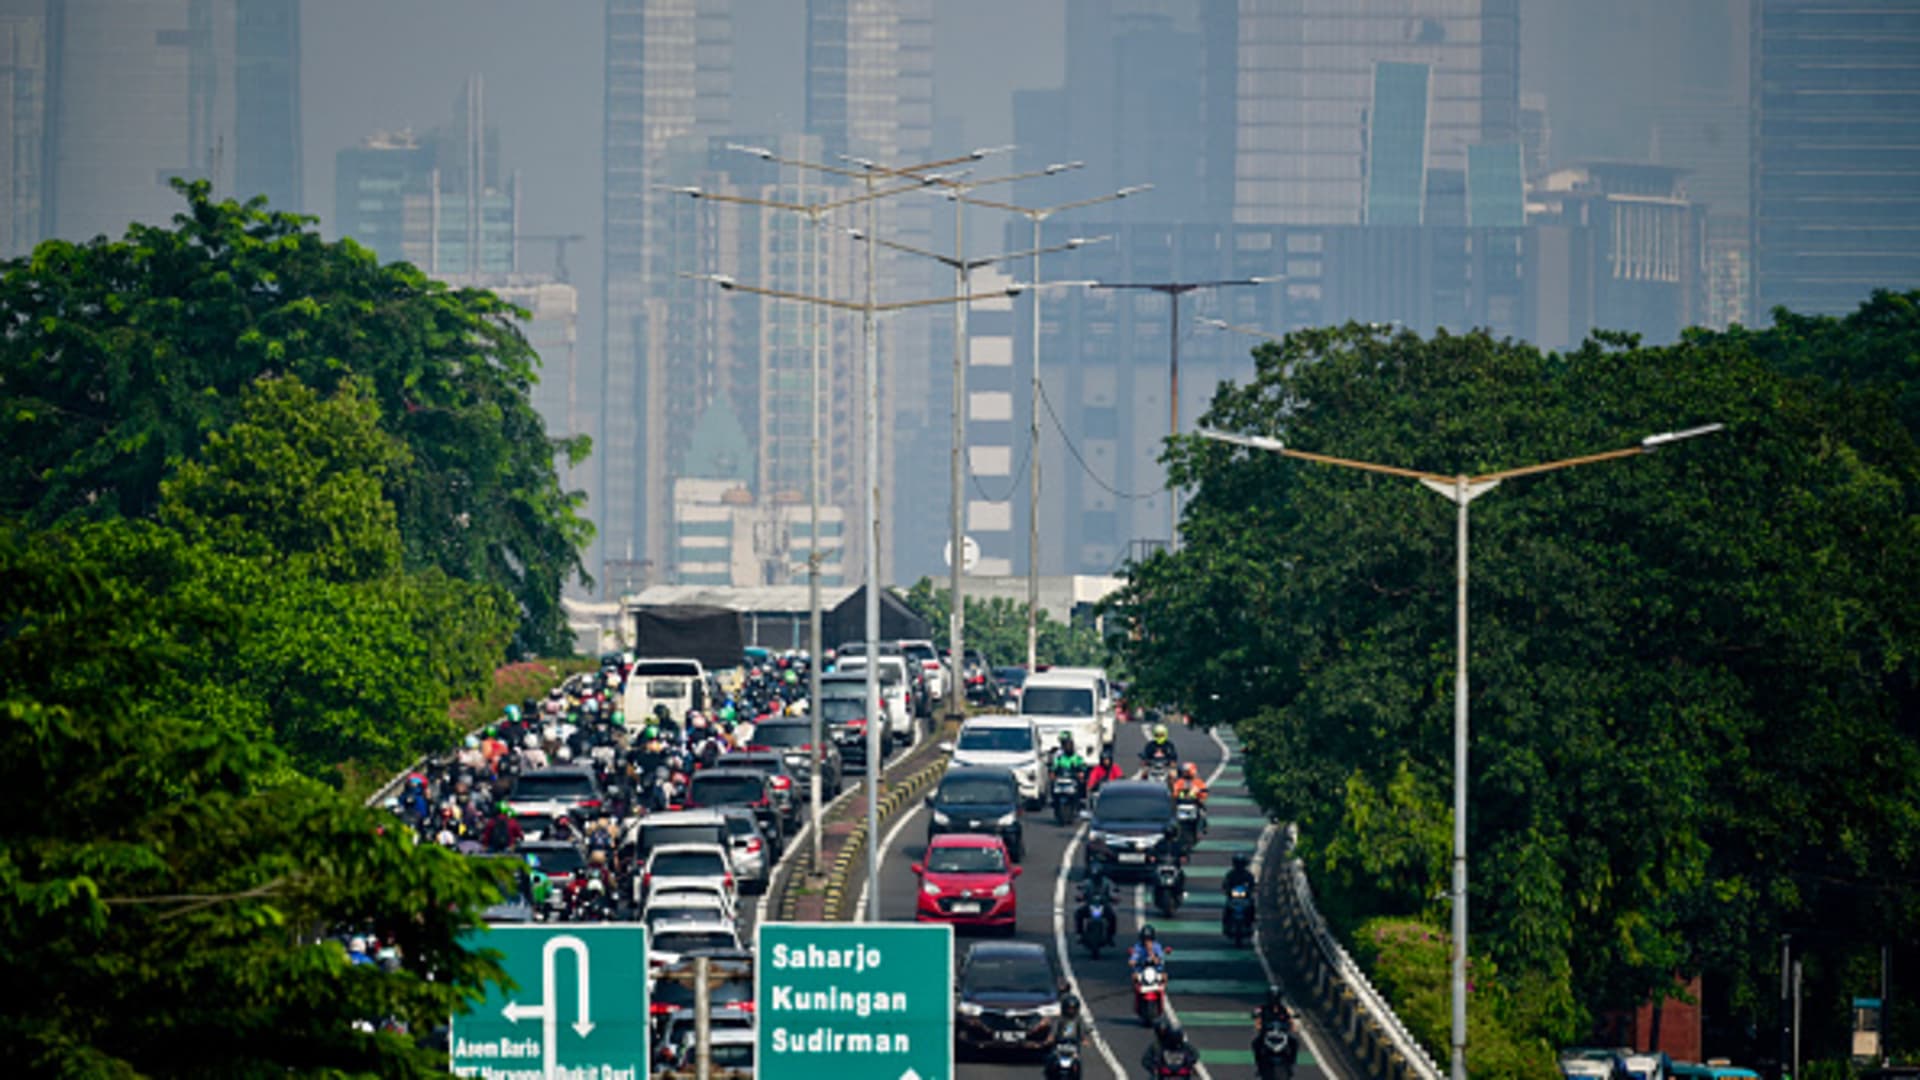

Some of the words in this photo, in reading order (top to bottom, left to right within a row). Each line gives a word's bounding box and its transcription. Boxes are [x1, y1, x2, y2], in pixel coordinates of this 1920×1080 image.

[772, 943, 881, 973] Saharjo
[772, 985, 907, 1017] Kuningan
[501, 1037, 540, 1058] Baris
[772, 1027, 910, 1053] Sudirman
